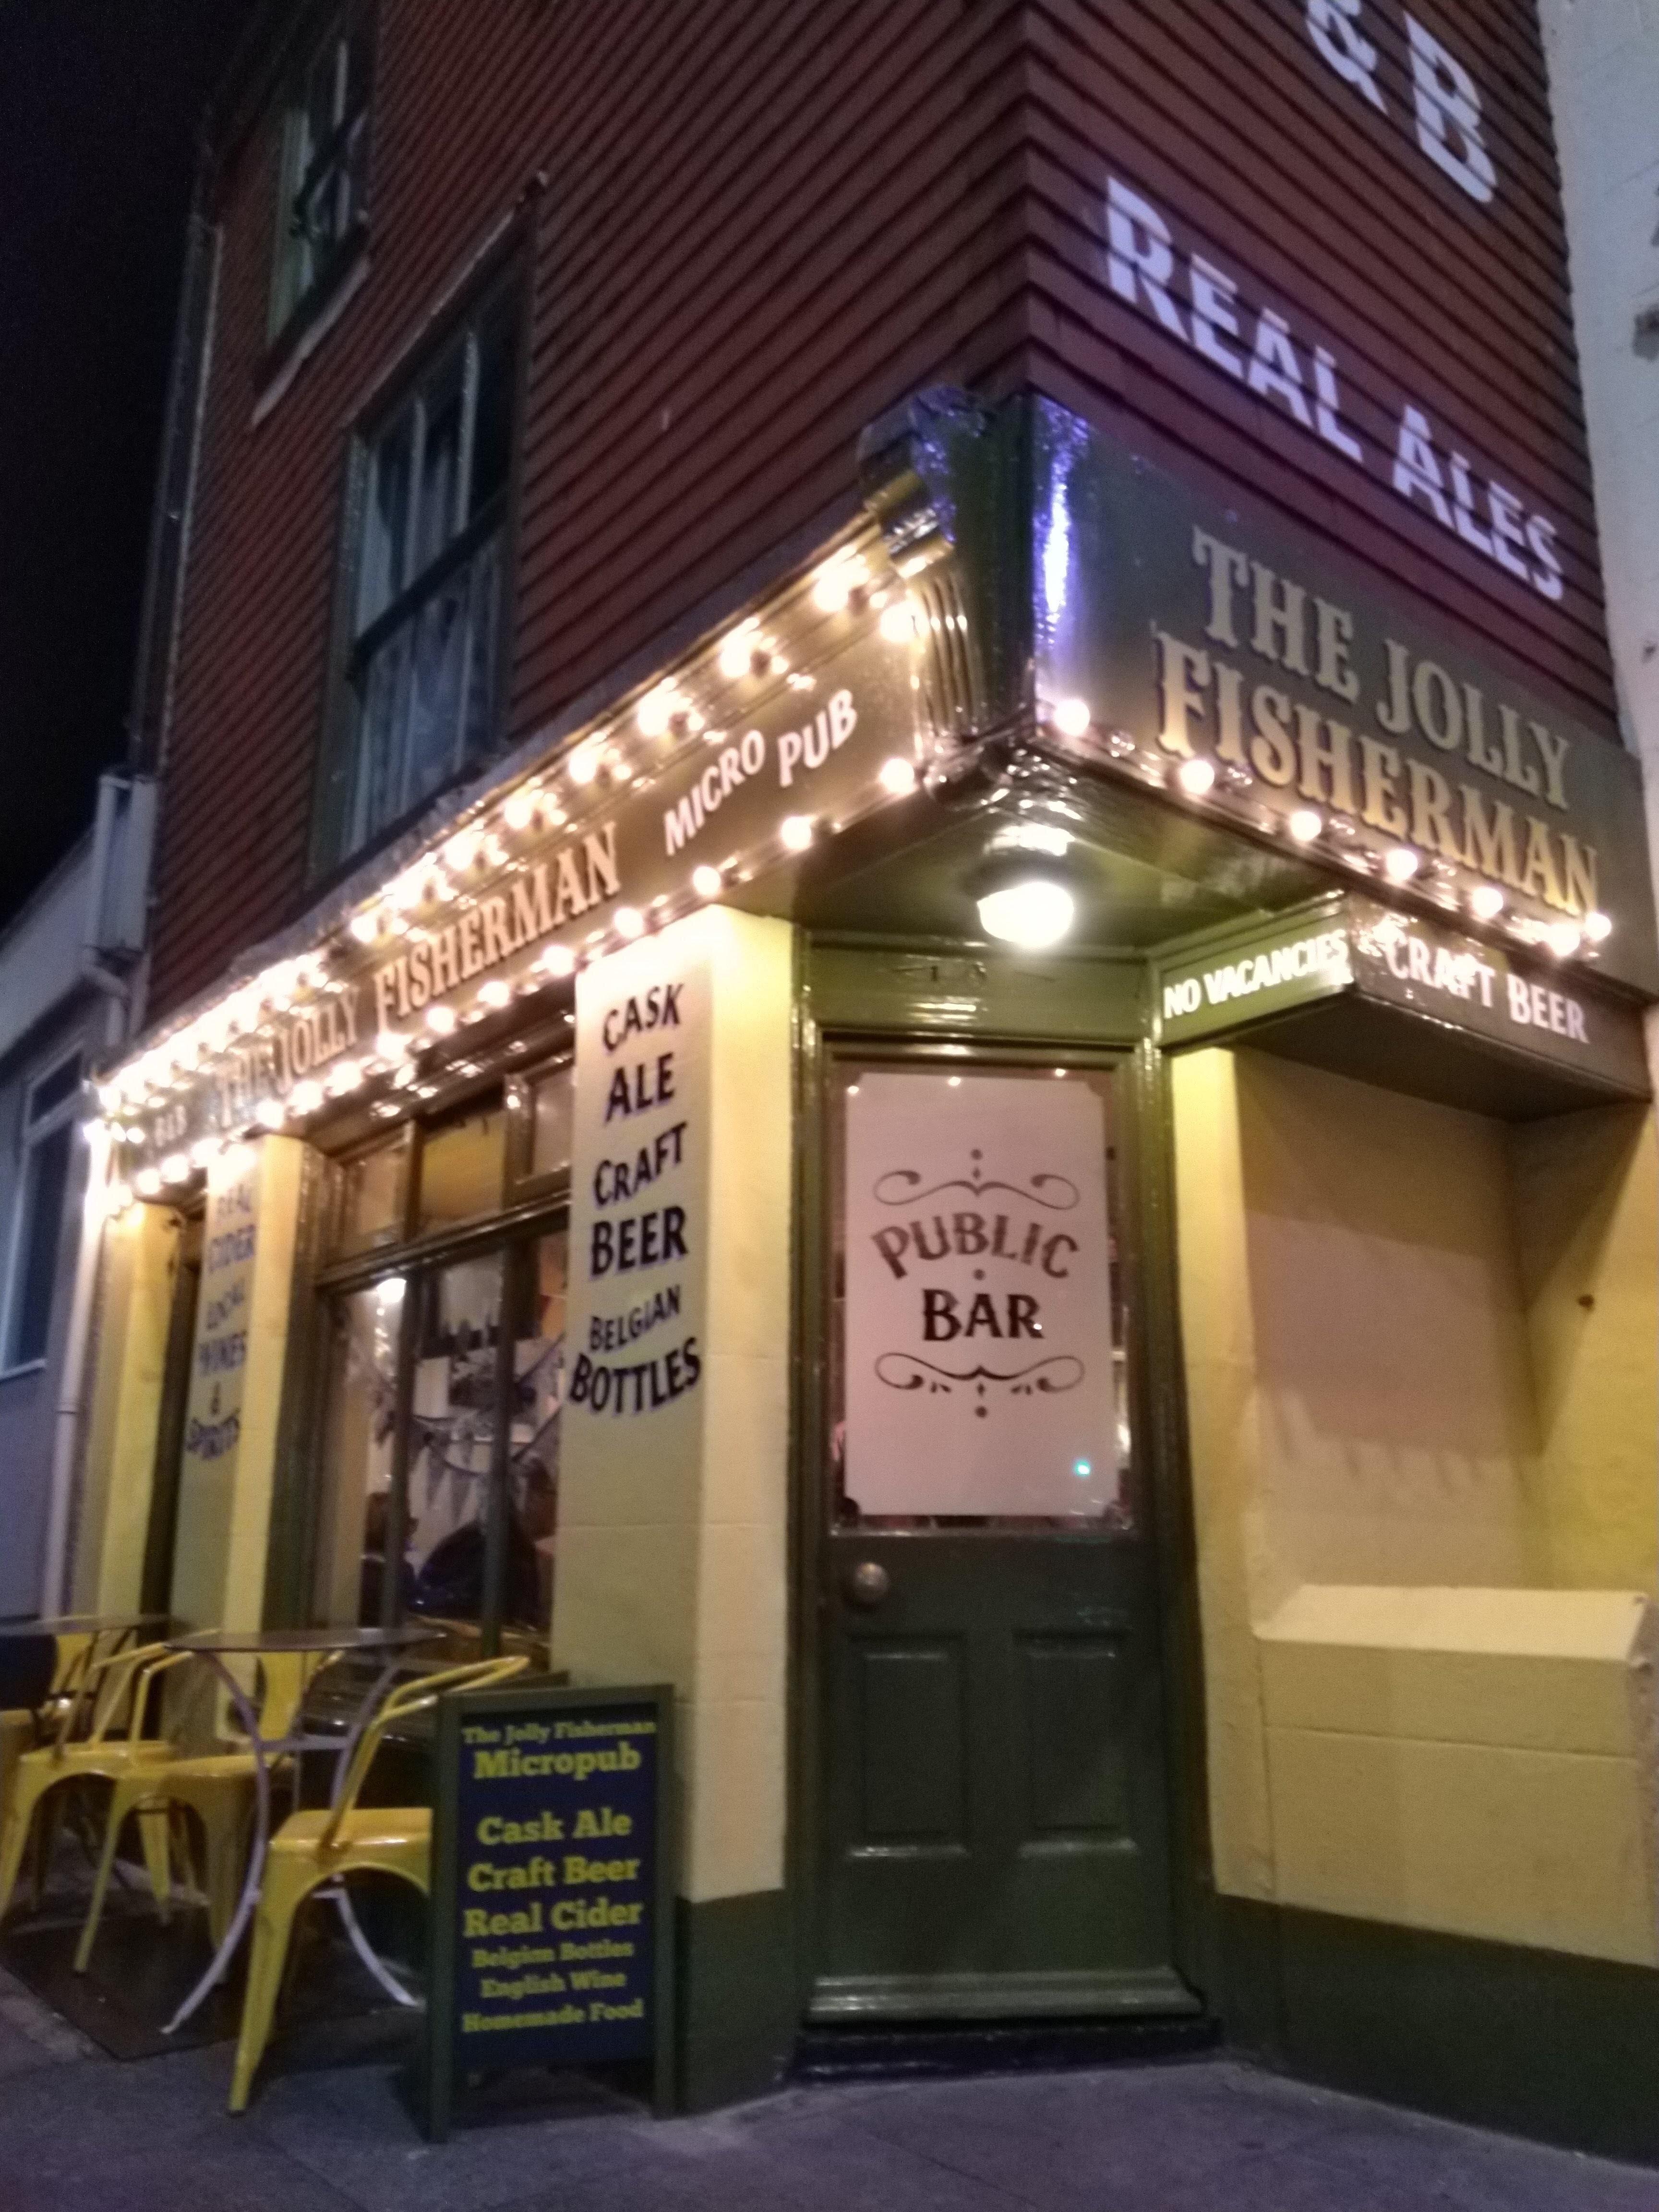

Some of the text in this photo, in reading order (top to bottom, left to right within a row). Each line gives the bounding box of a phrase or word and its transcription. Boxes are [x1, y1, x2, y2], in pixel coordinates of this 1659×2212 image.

[1403, 9, 1498, 203] B
[1107, 175, 1564, 601] REAL ALES
[1192, 524, 1570, 810] THE JOLLY
[662, 690, 858, 856] MICRO PUB
[1155, 631, 1599, 916] FISHERMAN
[273, 986, 360, 1095] JOLLY
[373, 822, 622, 1033] FISHERMAN
[1163, 929, 1350, 1019] NO VACANCIES
[1384, 926, 1589, 1044] CRAFT BEER
[602, 983, 686, 1053] CASK
[604, 1052, 676, 1127] ALE
[594, 1122, 688, 1210] CRAFT
[589, 1205, 689, 1280] BEER
[871, 1212, 1079, 1280] PUBLIC
[589, 1284, 682, 1353] BELGIAN
[921, 1287, 1045, 1342] BAR
[568, 1336, 701, 1418] BOTTLES
[473, 1740, 641, 1781] Micropub
[476, 1806, 633, 1846] Cask Ale
[468, 1855, 640, 1892] Craft Beer
[463, 1896, 643, 1938] Real Cider
